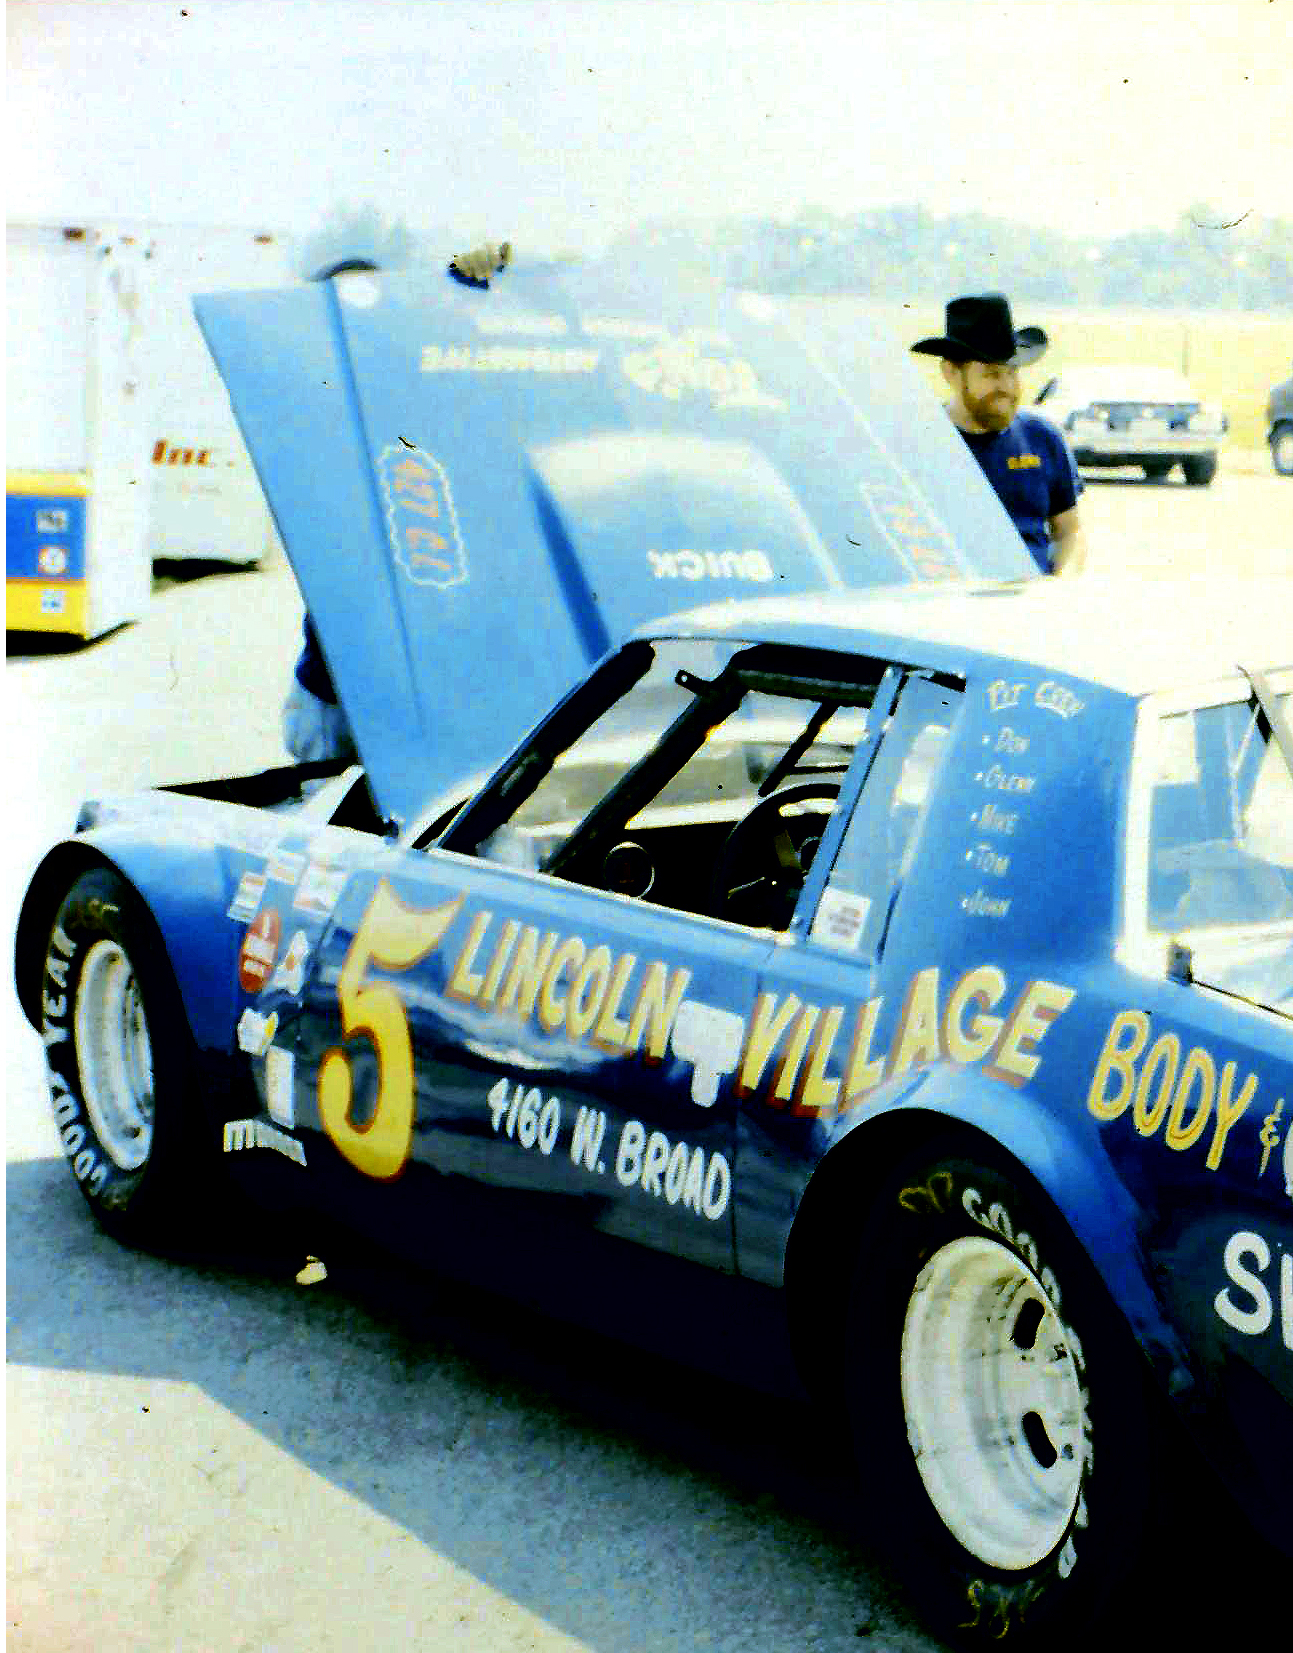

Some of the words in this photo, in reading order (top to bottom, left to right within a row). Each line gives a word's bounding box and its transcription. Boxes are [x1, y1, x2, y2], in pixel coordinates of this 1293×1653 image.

[316, 875, 470, 1184] 5
[445, 911, 691, 1067] LINCOLN
[733, 964, 1077, 1118] VILLAGE
[1087, 1010, 1259, 1171] BODY
[486, 1077, 561, 1156] 4160
[570, 1103, 607, 1175] W.
[616, 1120, 732, 1222] BROAD
